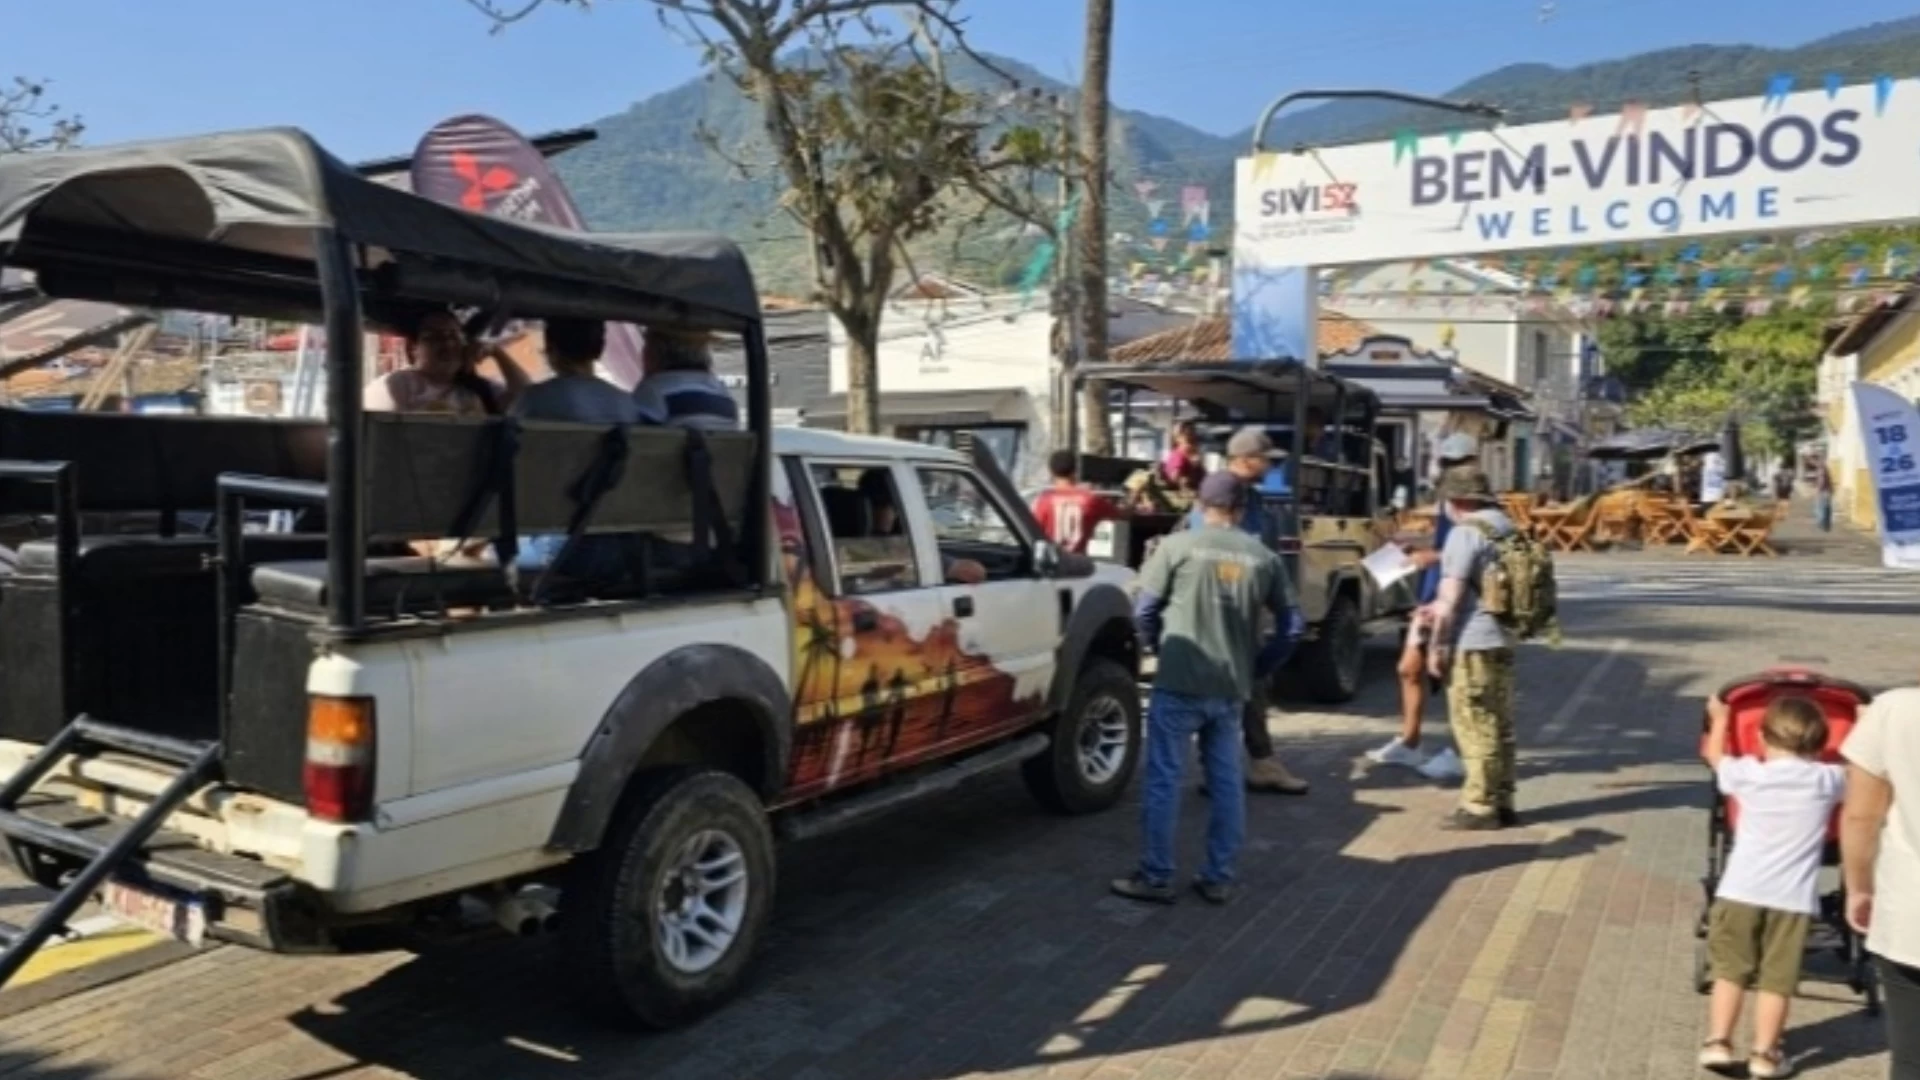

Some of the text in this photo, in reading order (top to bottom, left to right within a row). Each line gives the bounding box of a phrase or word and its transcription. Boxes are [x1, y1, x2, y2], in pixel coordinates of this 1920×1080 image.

[1411, 108, 1861, 207] BEM-VINDOS
[1477, 186, 1780, 240] WELCOME
[1874, 424, 1908, 445] 18
[1880, 454, 1916, 473] 26
